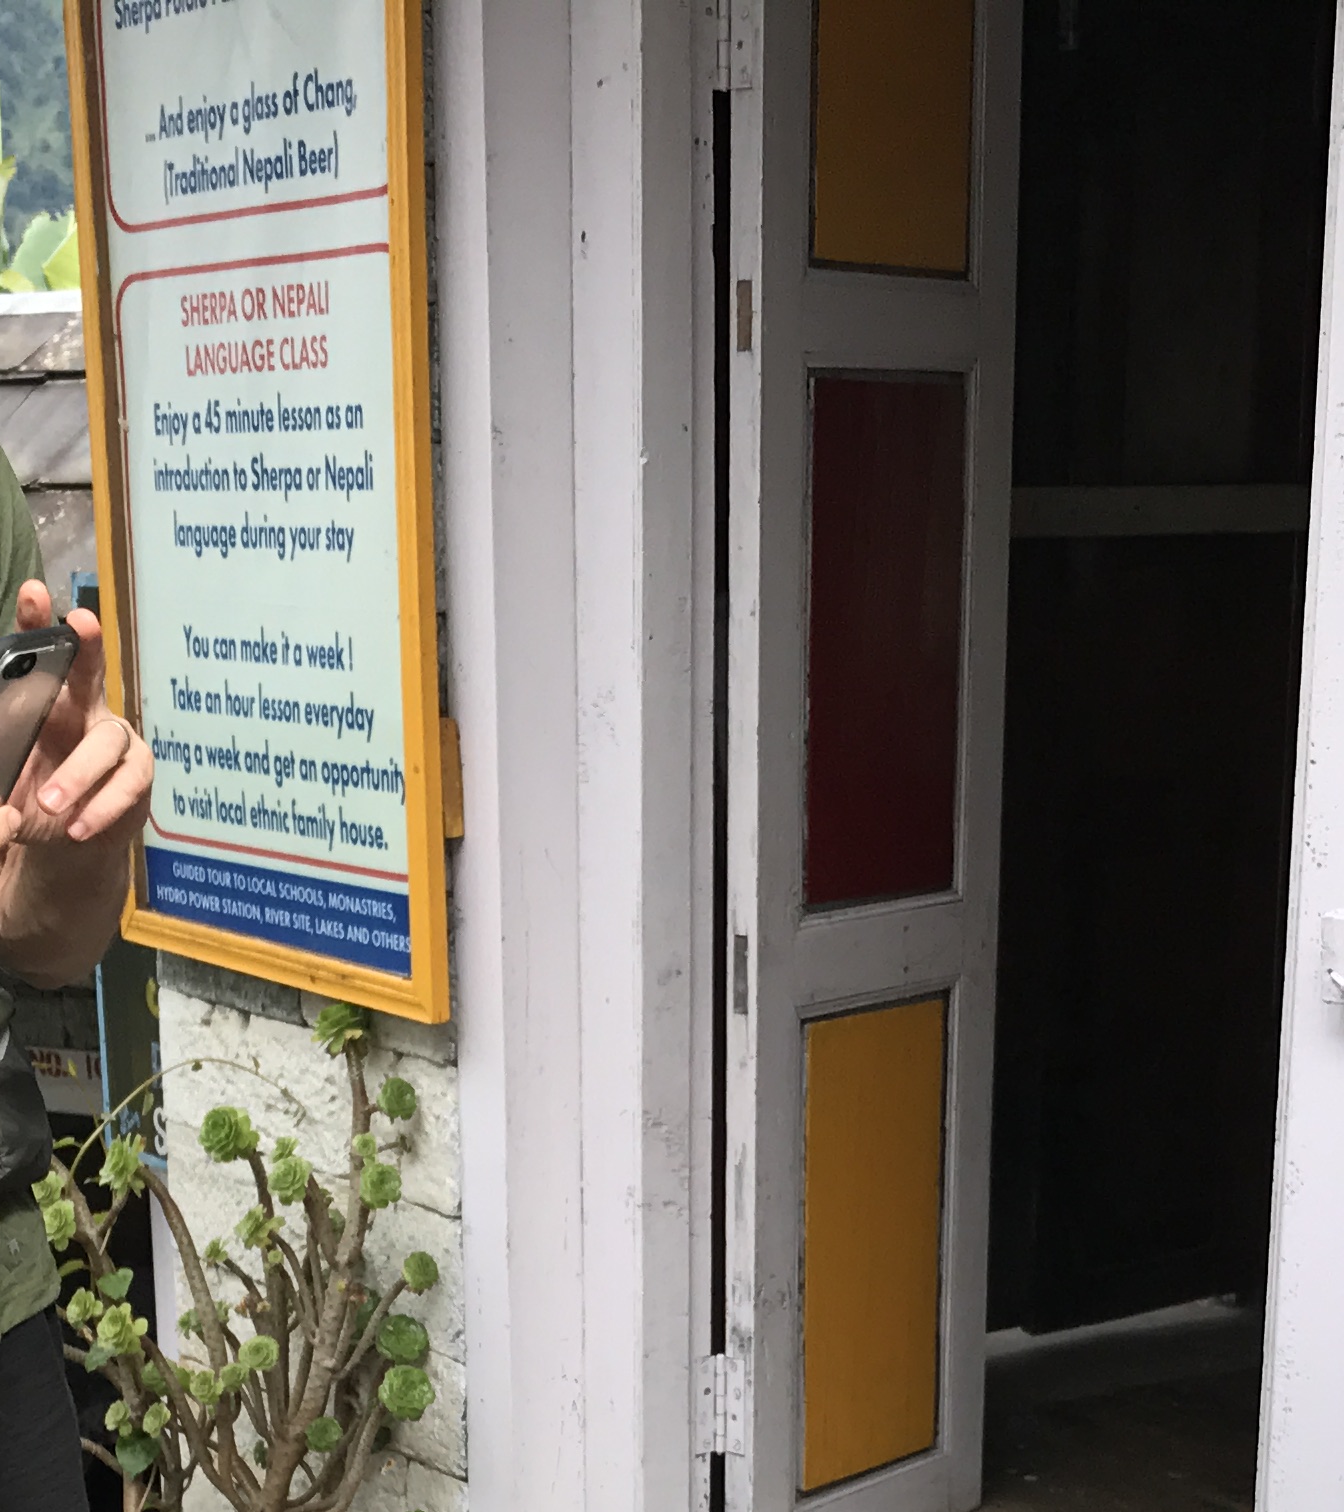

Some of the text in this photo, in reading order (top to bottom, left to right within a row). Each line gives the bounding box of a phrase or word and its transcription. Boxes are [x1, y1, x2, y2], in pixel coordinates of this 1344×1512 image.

[115, 0, 161, 34] Sherpa
[188, 94, 225, 143] enjoy
[230, 103, 239, 125] a
[242, 81, 278, 135] glass
[282, 72, 299, 116] of
[164, 130, 339, 204] (Traditional Nepali Beer)
[181, 281, 330, 327] SHERPA OR NEPALI
[186, 335, 328, 377] LANGUAGE CLASS
[154, 392, 363, 446] Enjoy a 45 minute lesson as an
[154, 450, 374, 502] introduction to Sherpa or Nepali
[173, 510, 354, 563] language during your stay
[183, 624, 209, 660] You
[213, 636, 236, 661] can
[241, 626, 277, 665] make
[281, 631, 290, 667] it
[294, 643, 302, 667] a
[171, 678, 374, 742] Take an hour lesson everyday
[152, 725, 405, 806] during a week and get an opportunity
[173, 787, 388, 851] to visit local ethnic family house.
[157, 885, 410, 953] HYDRO POWER STATION, RIVER SITE, LAKES AND OTHERS
[172, 861, 396, 921] GUIDED TOUR TO LOCAL SCHOOLS, MONASTRIES,
